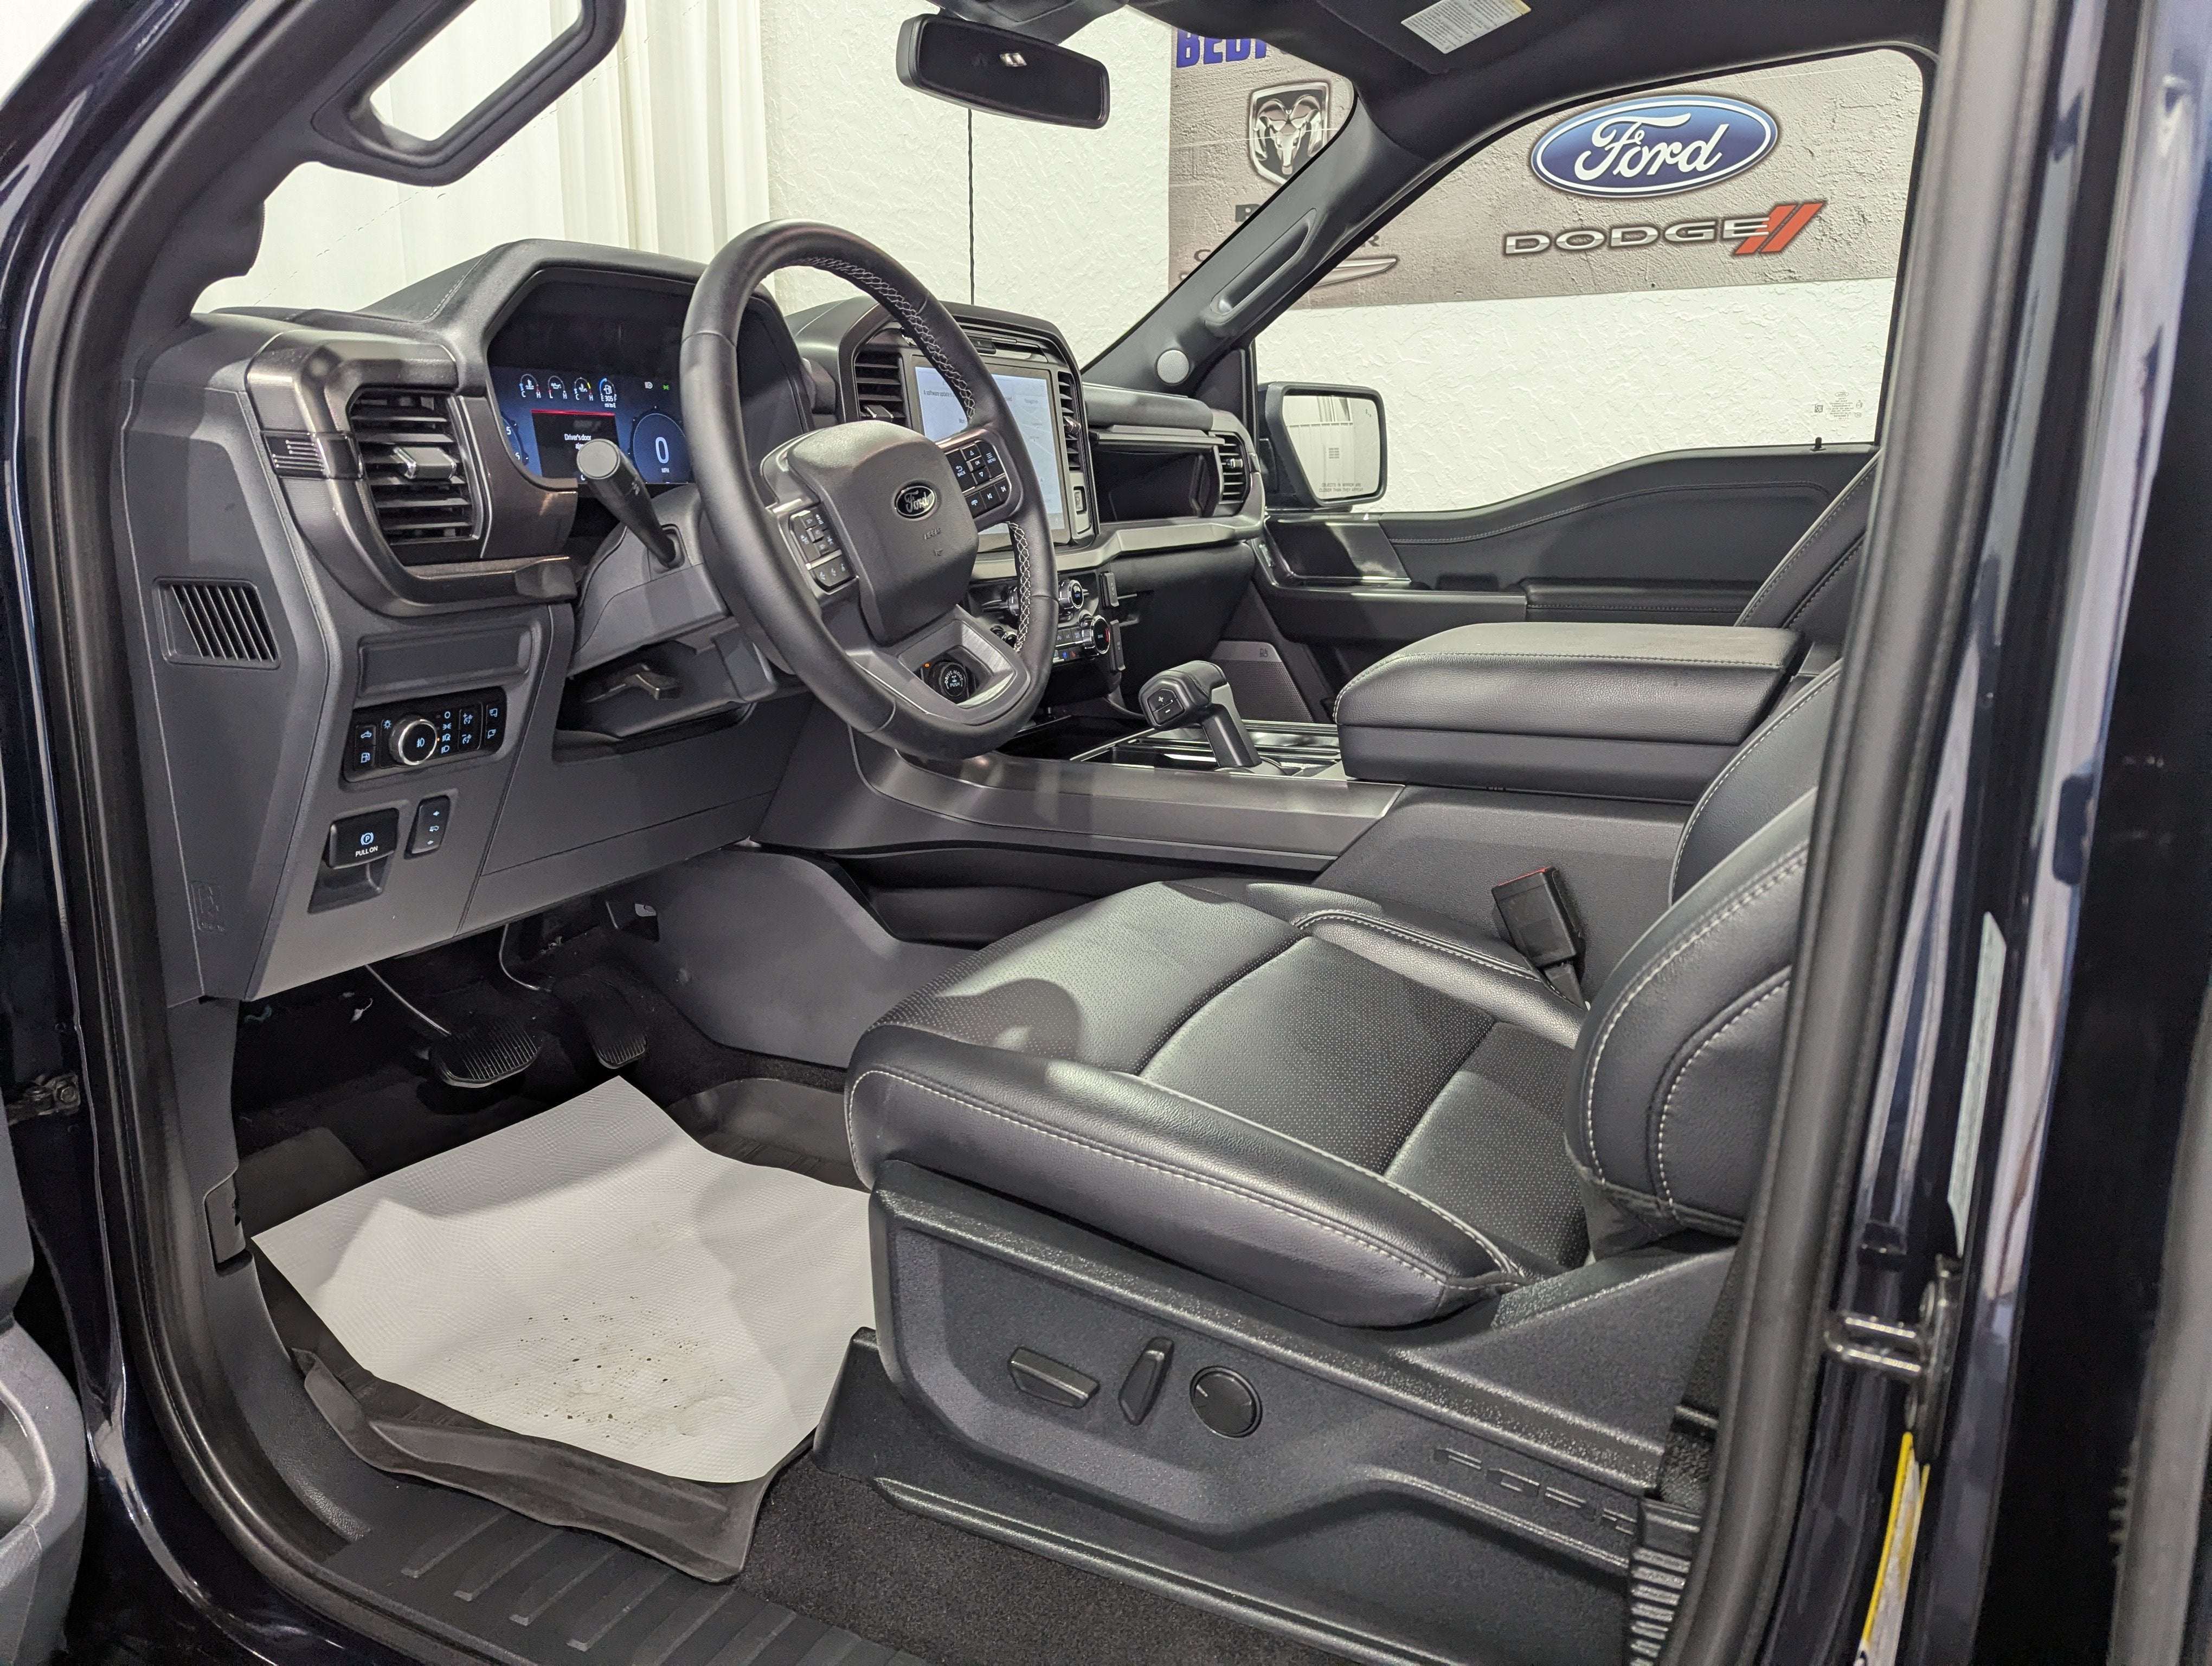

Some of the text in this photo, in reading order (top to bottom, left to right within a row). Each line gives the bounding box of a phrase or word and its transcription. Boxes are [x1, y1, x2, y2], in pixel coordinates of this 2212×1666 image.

[1574, 112, 1729, 181] Ford
[1503, 216, 1771, 255] DODGE
[506, 426, 511, 435] 5
[655, 437, 669, 464] 0
[904, 490, 929, 513] Ford
[944, 670, 963, 684] DRIVE MODE
[355, 848, 369, 857] PULL
